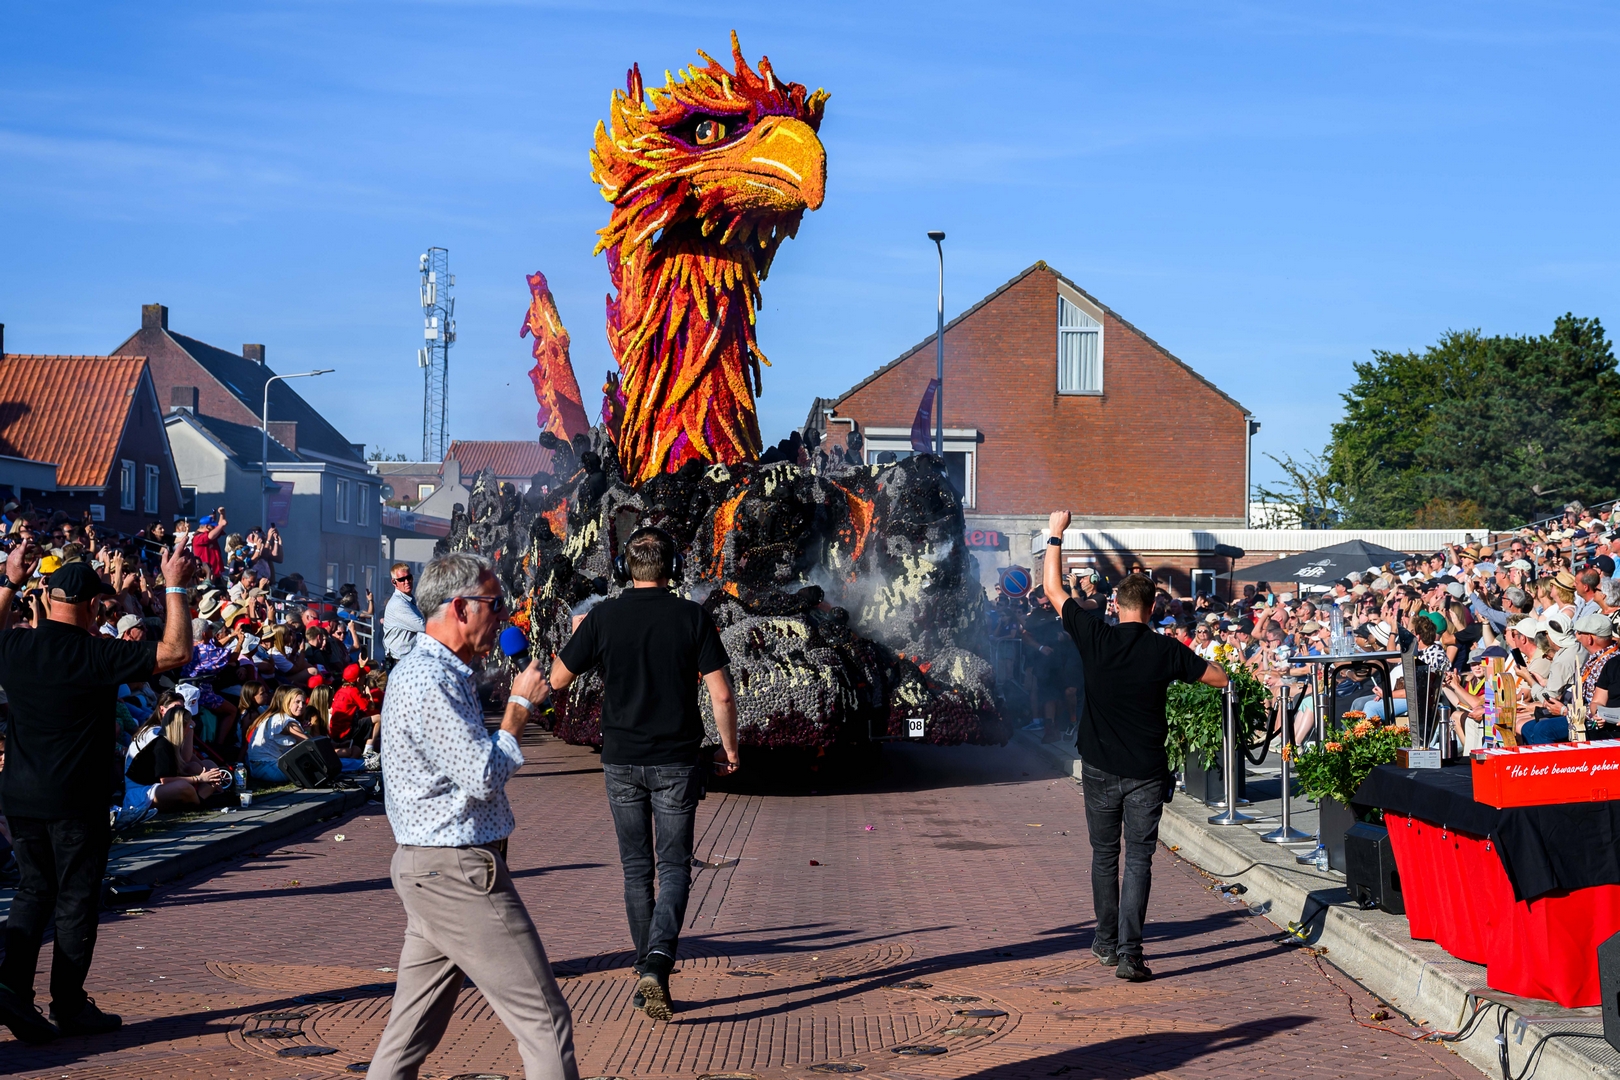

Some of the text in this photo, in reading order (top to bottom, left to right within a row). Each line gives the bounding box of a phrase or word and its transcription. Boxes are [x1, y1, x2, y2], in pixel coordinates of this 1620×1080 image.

[910, 721, 922, 731] 08
[1530, 765, 1549, 776] best
[1551, 761, 1588, 775] bewaarde
[1590, 760, 1619, 776] geheim
